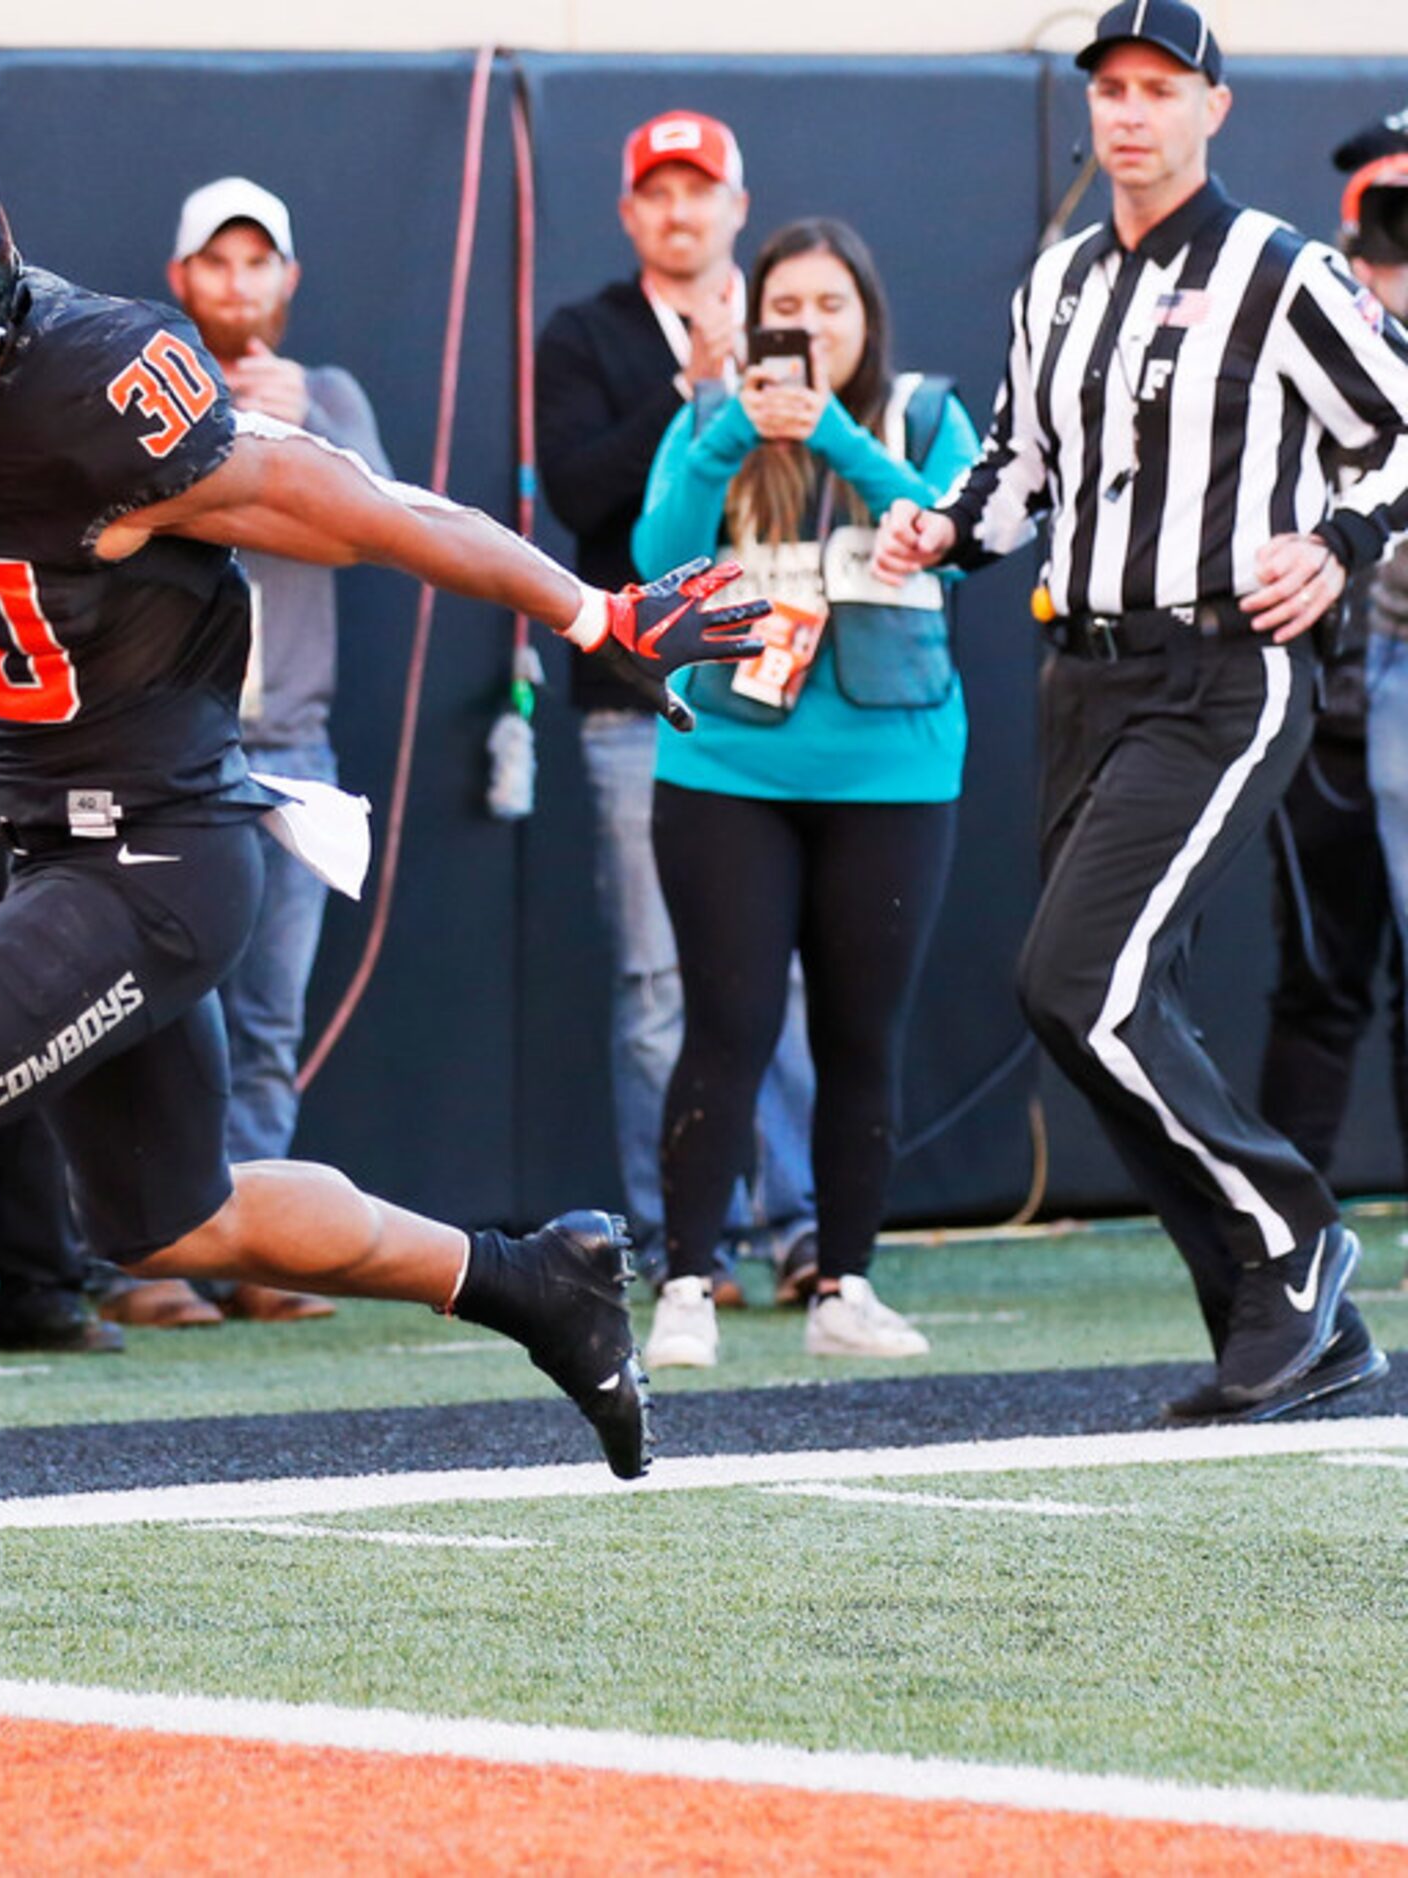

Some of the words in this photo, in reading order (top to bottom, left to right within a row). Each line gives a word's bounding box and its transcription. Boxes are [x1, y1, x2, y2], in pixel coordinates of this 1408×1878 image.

[1053, 296, 1080, 325] S
[107, 328, 218, 458] 30
[1140, 359, 1175, 401] F
